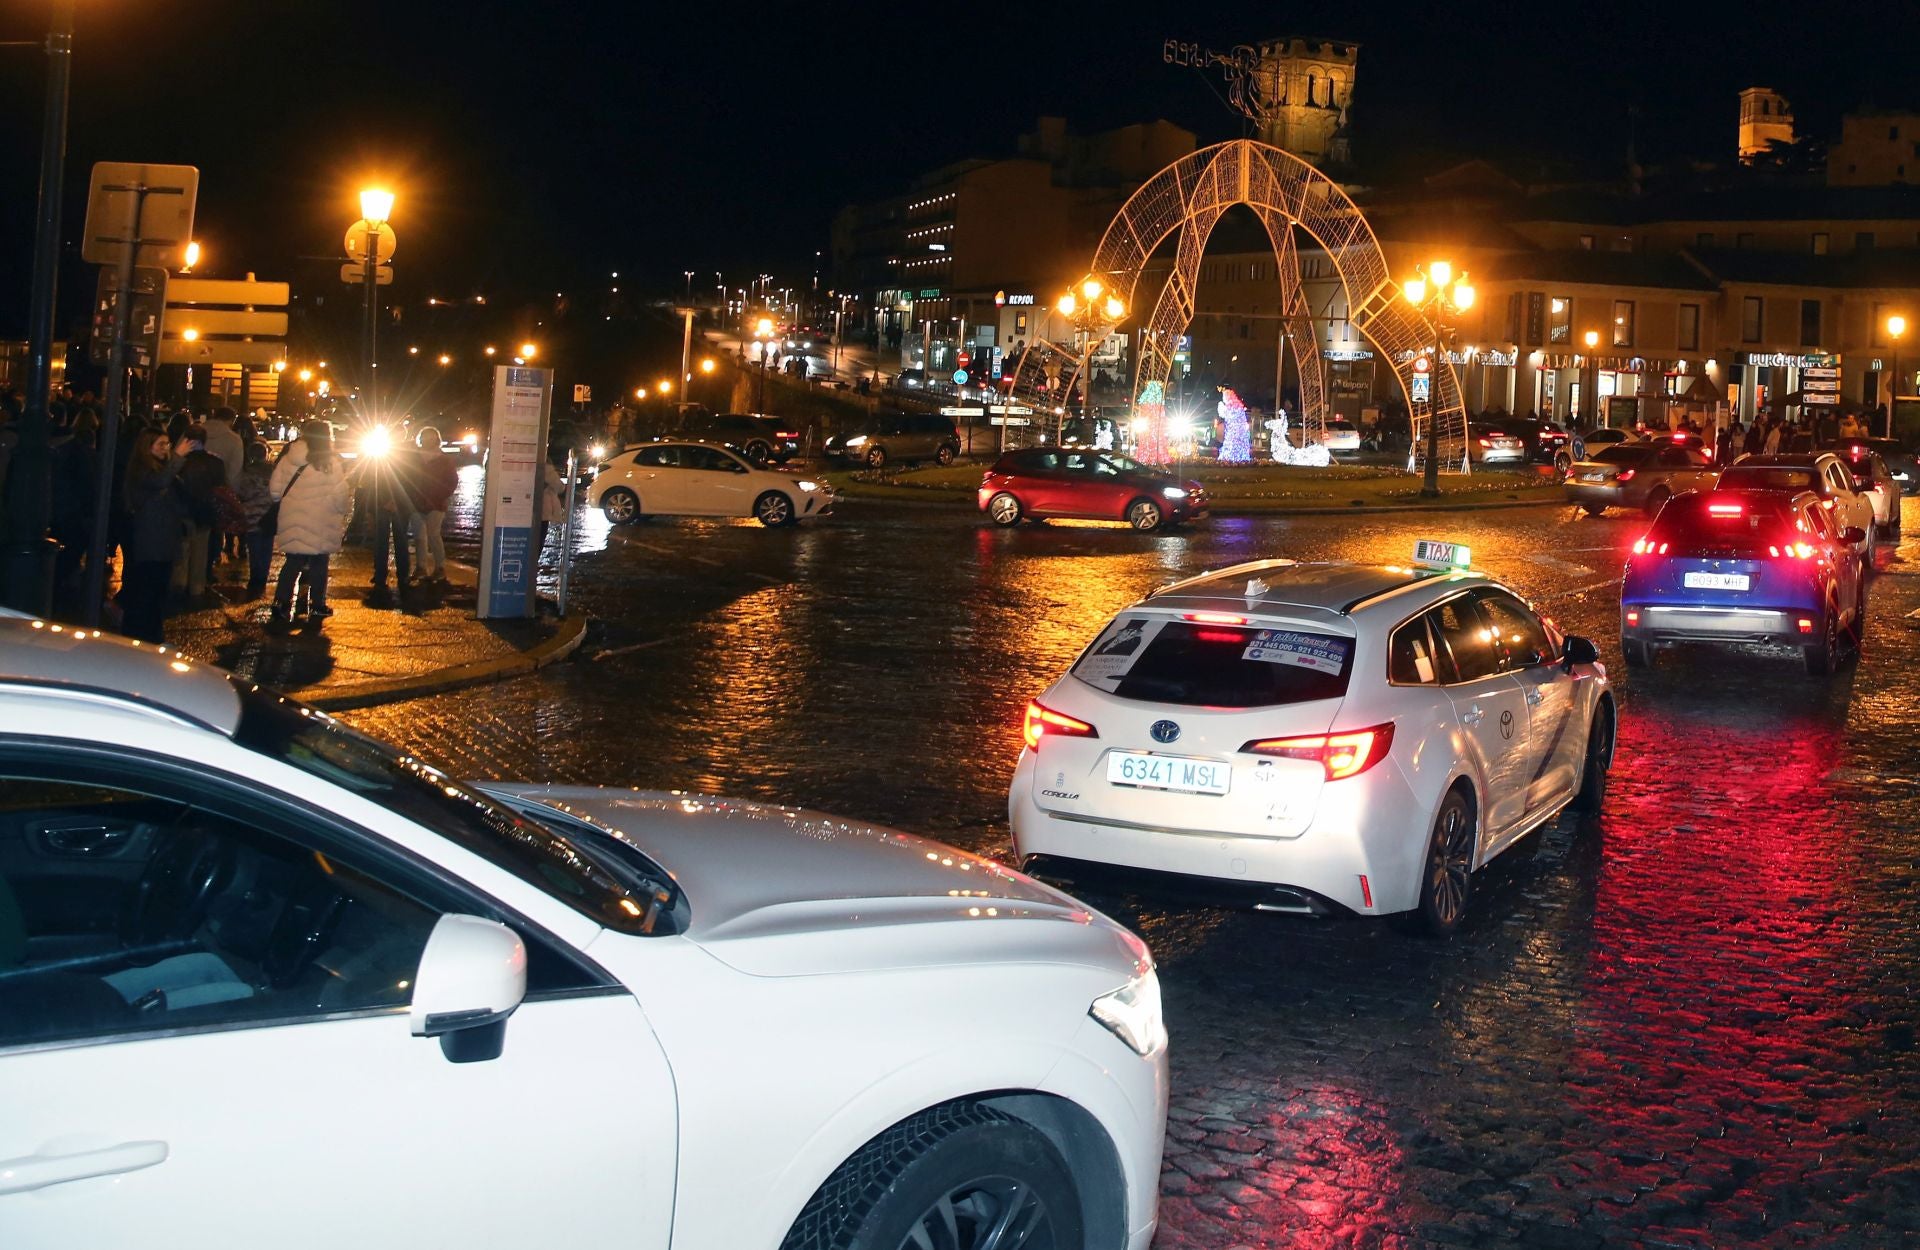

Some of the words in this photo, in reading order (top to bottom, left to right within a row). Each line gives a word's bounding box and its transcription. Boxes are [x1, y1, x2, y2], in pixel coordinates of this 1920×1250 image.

[1009, 294, 1034, 305] REPSOL
[1749, 352, 1796, 368] BURGER
[1428, 542, 1456, 563] TAXI
[1249, 640, 1263, 648] 921
[1298, 646, 1311, 654] 921
[1313, 650, 1327, 658] 922
[1329, 653, 1343, 662] 499
[1122, 758, 1173, 784] 6341
[1183, 764, 1223, 789] MSL
[1041, 789, 1080, 800] COROLLA
